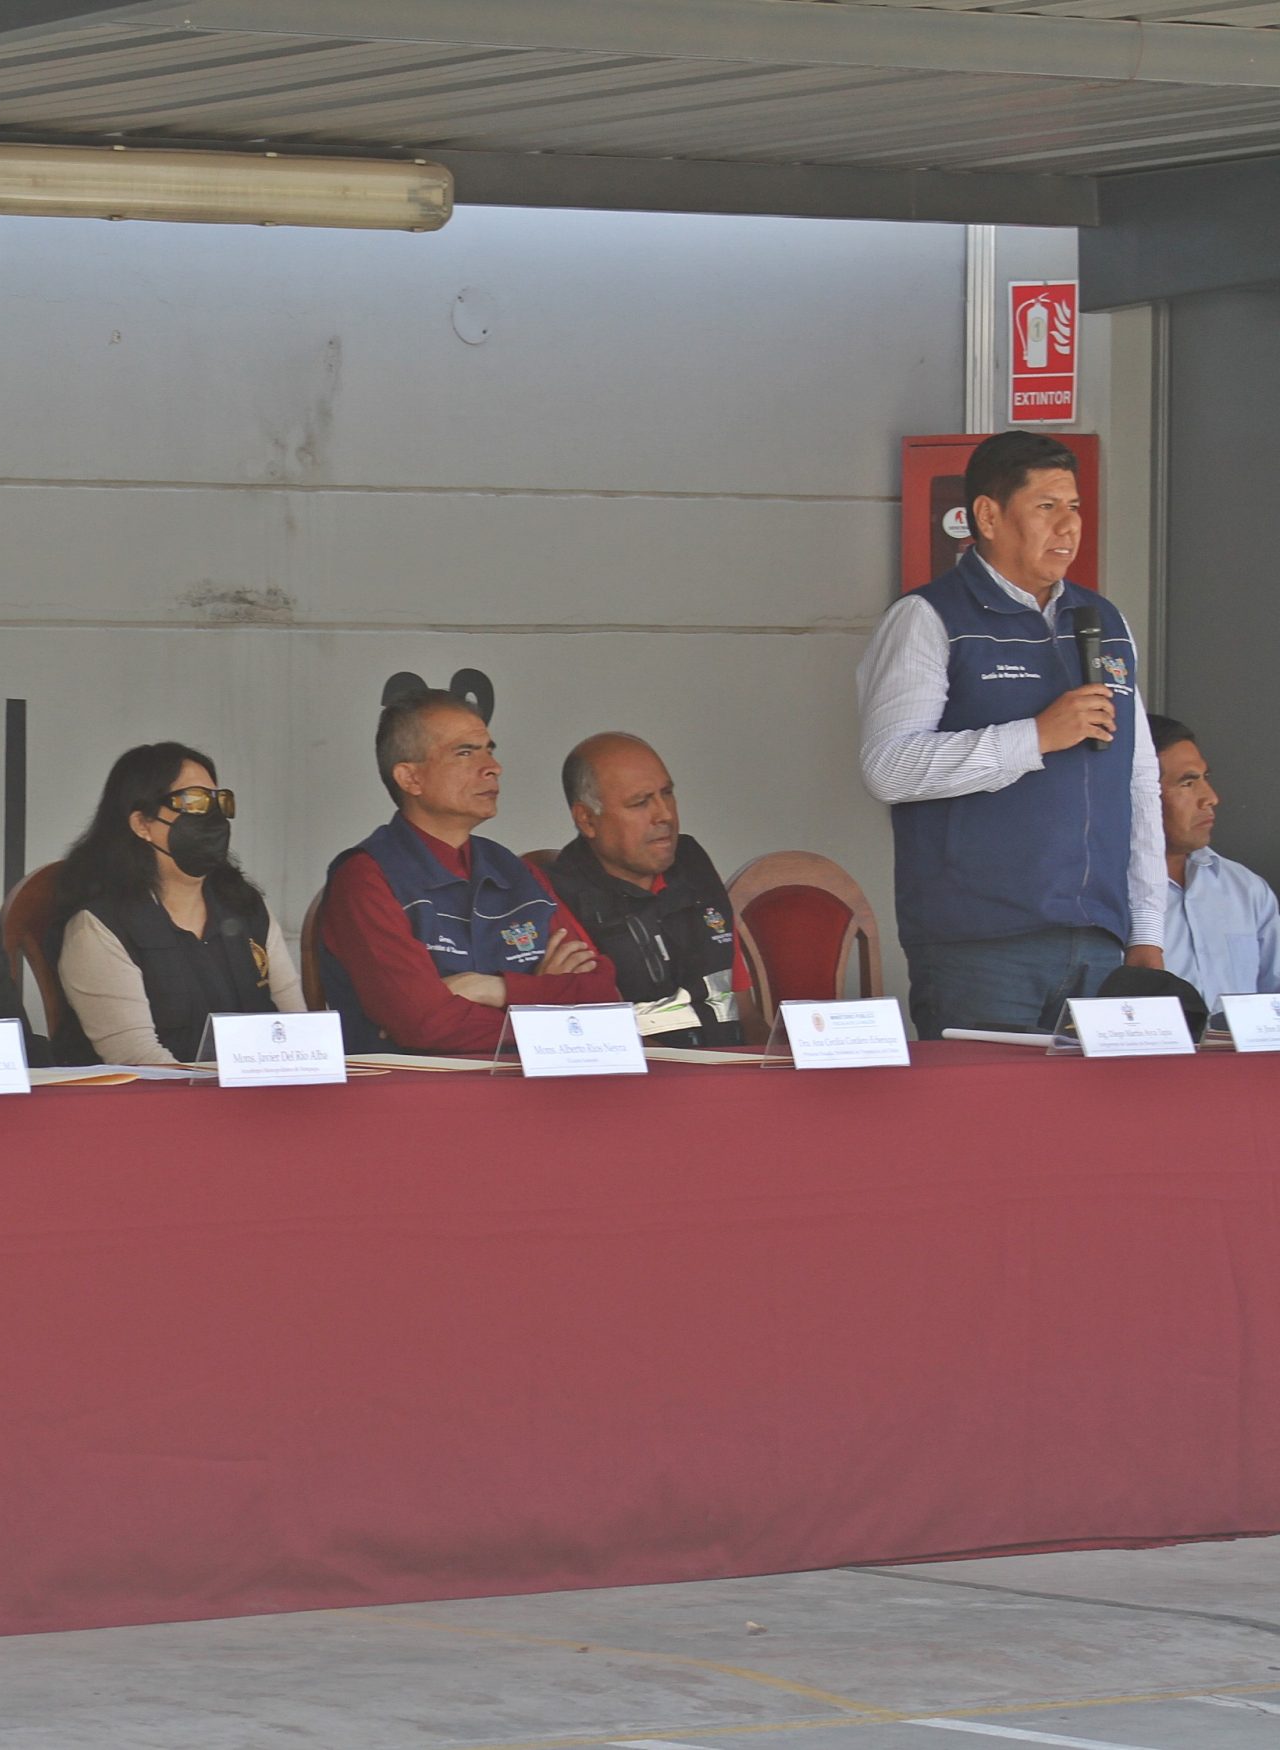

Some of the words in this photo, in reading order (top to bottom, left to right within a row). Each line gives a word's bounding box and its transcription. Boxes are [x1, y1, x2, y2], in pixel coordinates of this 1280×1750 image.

[1014, 391, 1071, 406] EXTINTOR
[232, 1053, 257, 1064] Mons.
[280, 1050, 294, 1062] Del
[310, 1049, 328, 1061] Alba
